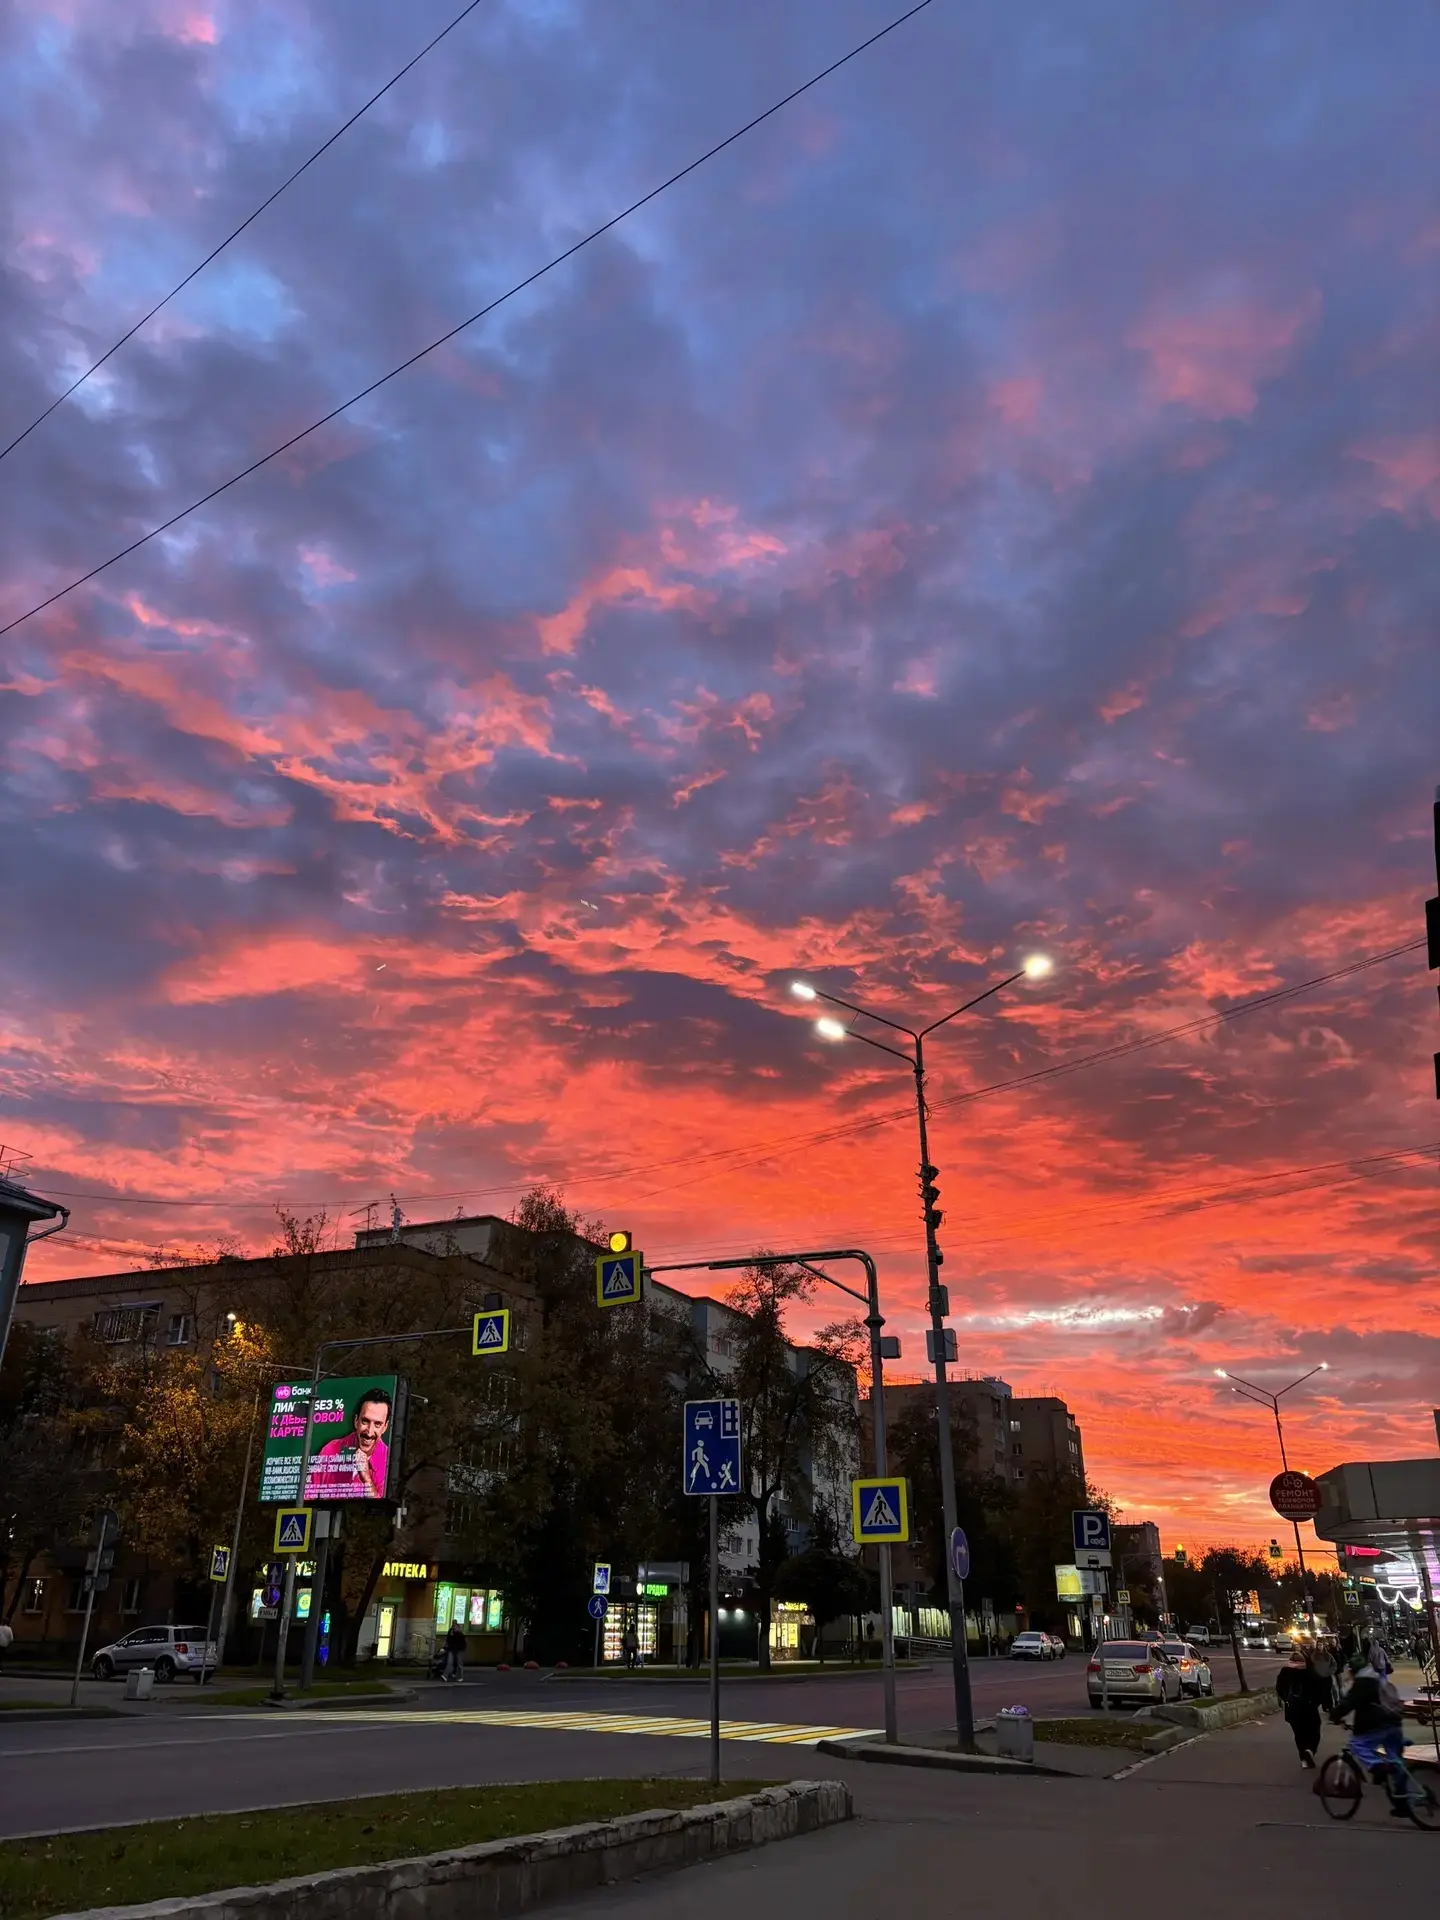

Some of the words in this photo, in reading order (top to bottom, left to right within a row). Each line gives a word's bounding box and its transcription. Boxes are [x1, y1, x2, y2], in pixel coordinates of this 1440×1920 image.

[335, 1399, 344, 1410] %
[271, 1415, 279, 1426] К
[270, 1426, 304, 1438] КАРТЕ
[1276, 1489, 1314, 1498] РЕМОНТ
[382, 1561, 427, 1579] АПТЕКА
